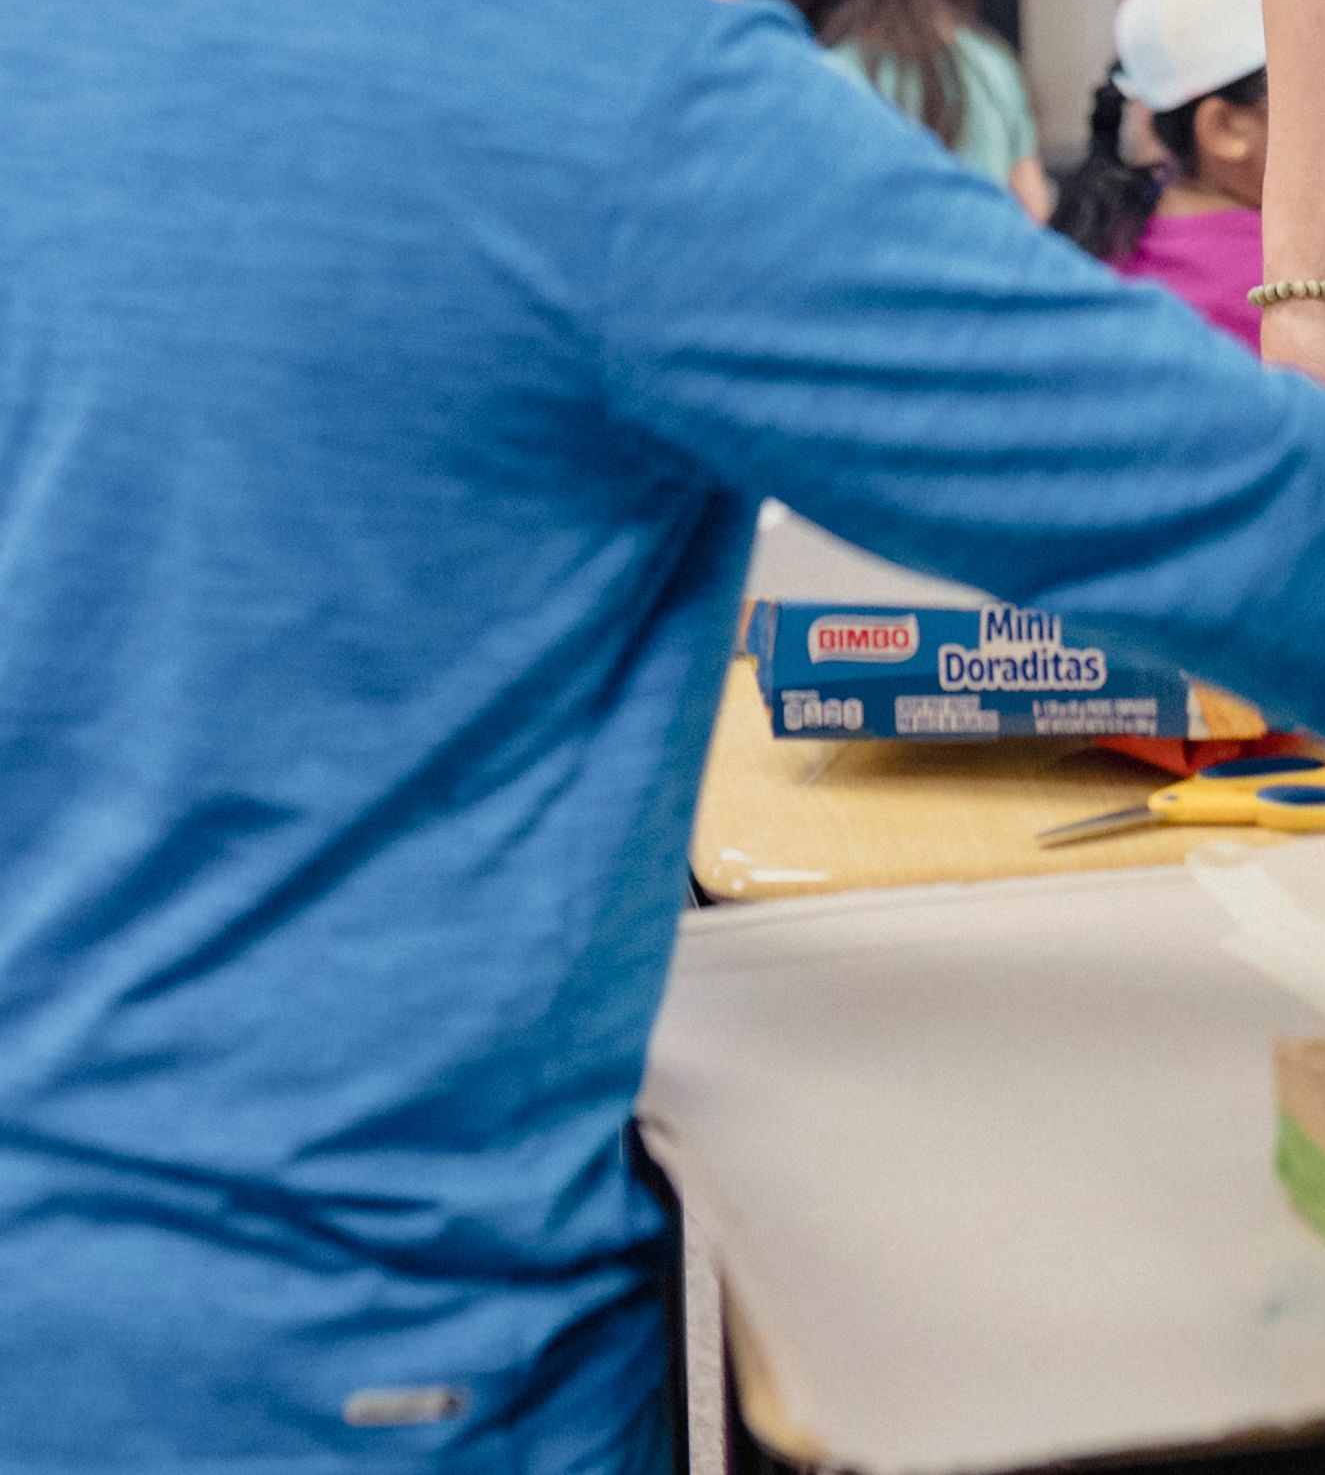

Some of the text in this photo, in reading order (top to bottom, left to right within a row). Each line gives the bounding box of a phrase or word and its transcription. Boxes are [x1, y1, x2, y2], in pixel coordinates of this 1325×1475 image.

[818, 627, 910, 650] BIMBO
[986, 608, 1055, 642] Mini
[946, 649, 1100, 683] Doraditas
